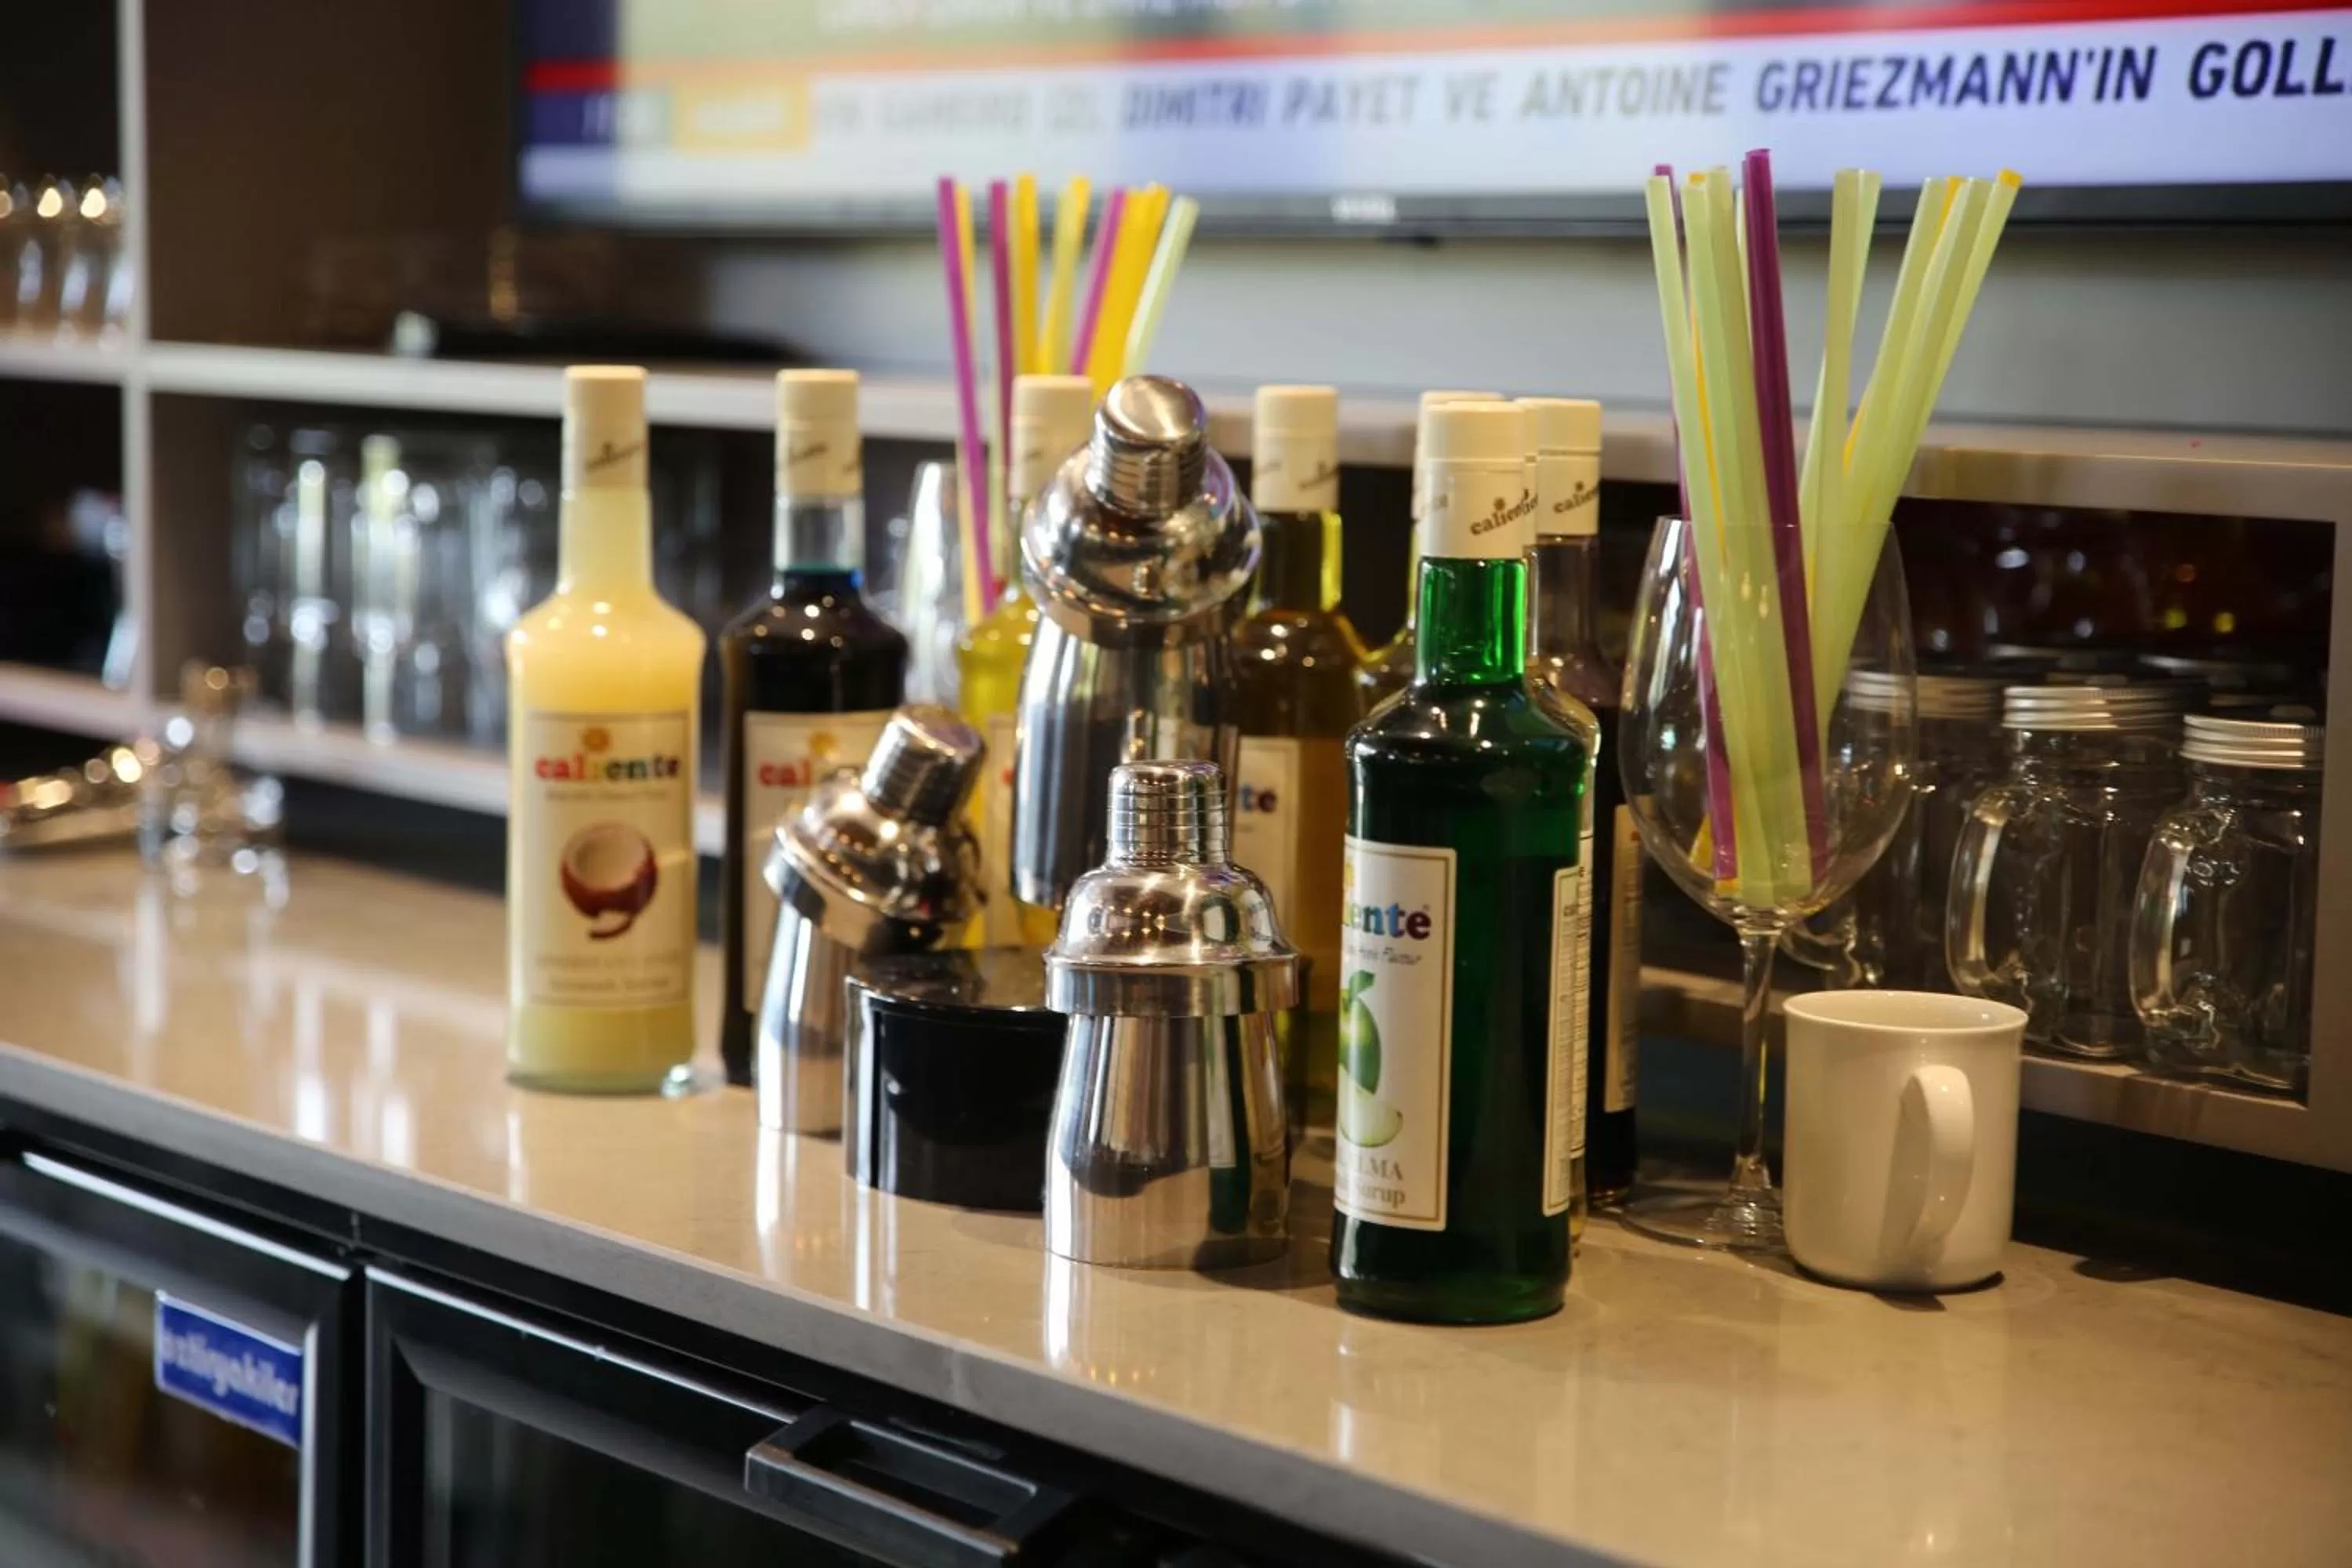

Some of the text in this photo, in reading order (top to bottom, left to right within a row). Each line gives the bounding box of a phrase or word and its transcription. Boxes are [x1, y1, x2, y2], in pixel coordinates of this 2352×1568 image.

[1520, 62, 1730, 118] ANTOINE
[1755, 45, 2158, 114] GRIEZMANN'IN
[2188, 36, 2352, 100] GOLL
